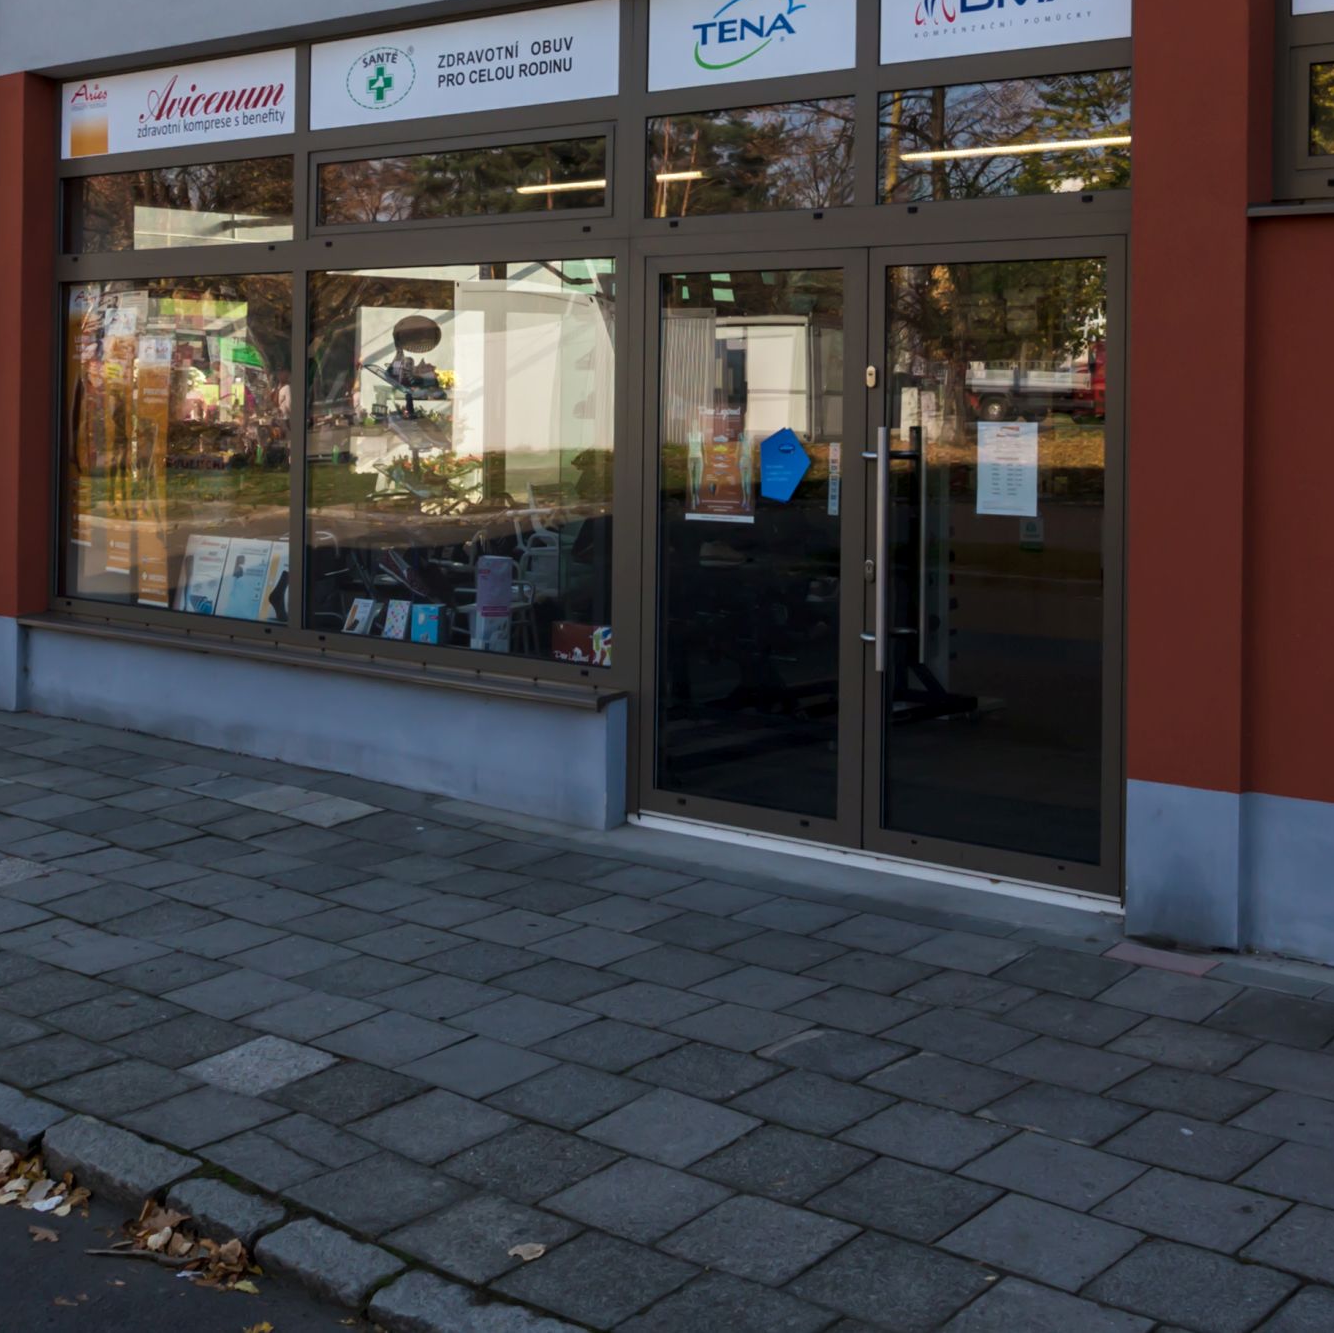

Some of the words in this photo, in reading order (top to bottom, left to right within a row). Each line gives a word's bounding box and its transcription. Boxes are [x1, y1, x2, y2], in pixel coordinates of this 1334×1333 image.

[692, 13, 796, 45] TENA
[437, 41, 519, 69] ZDRAVOTNÍ
[531, 37, 574, 56] OBUV
[437, 74, 465, 88] PRO
[469, 66, 514, 85] CELOU
[519, 57, 573, 78] RODINU
[71, 83, 108, 104] Aries
[138, 74, 286, 124] Avicenum
[137, 120, 181, 139] zdravotní
[184, 116, 232, 135] komprese
[242, 108, 286, 126] benefity
